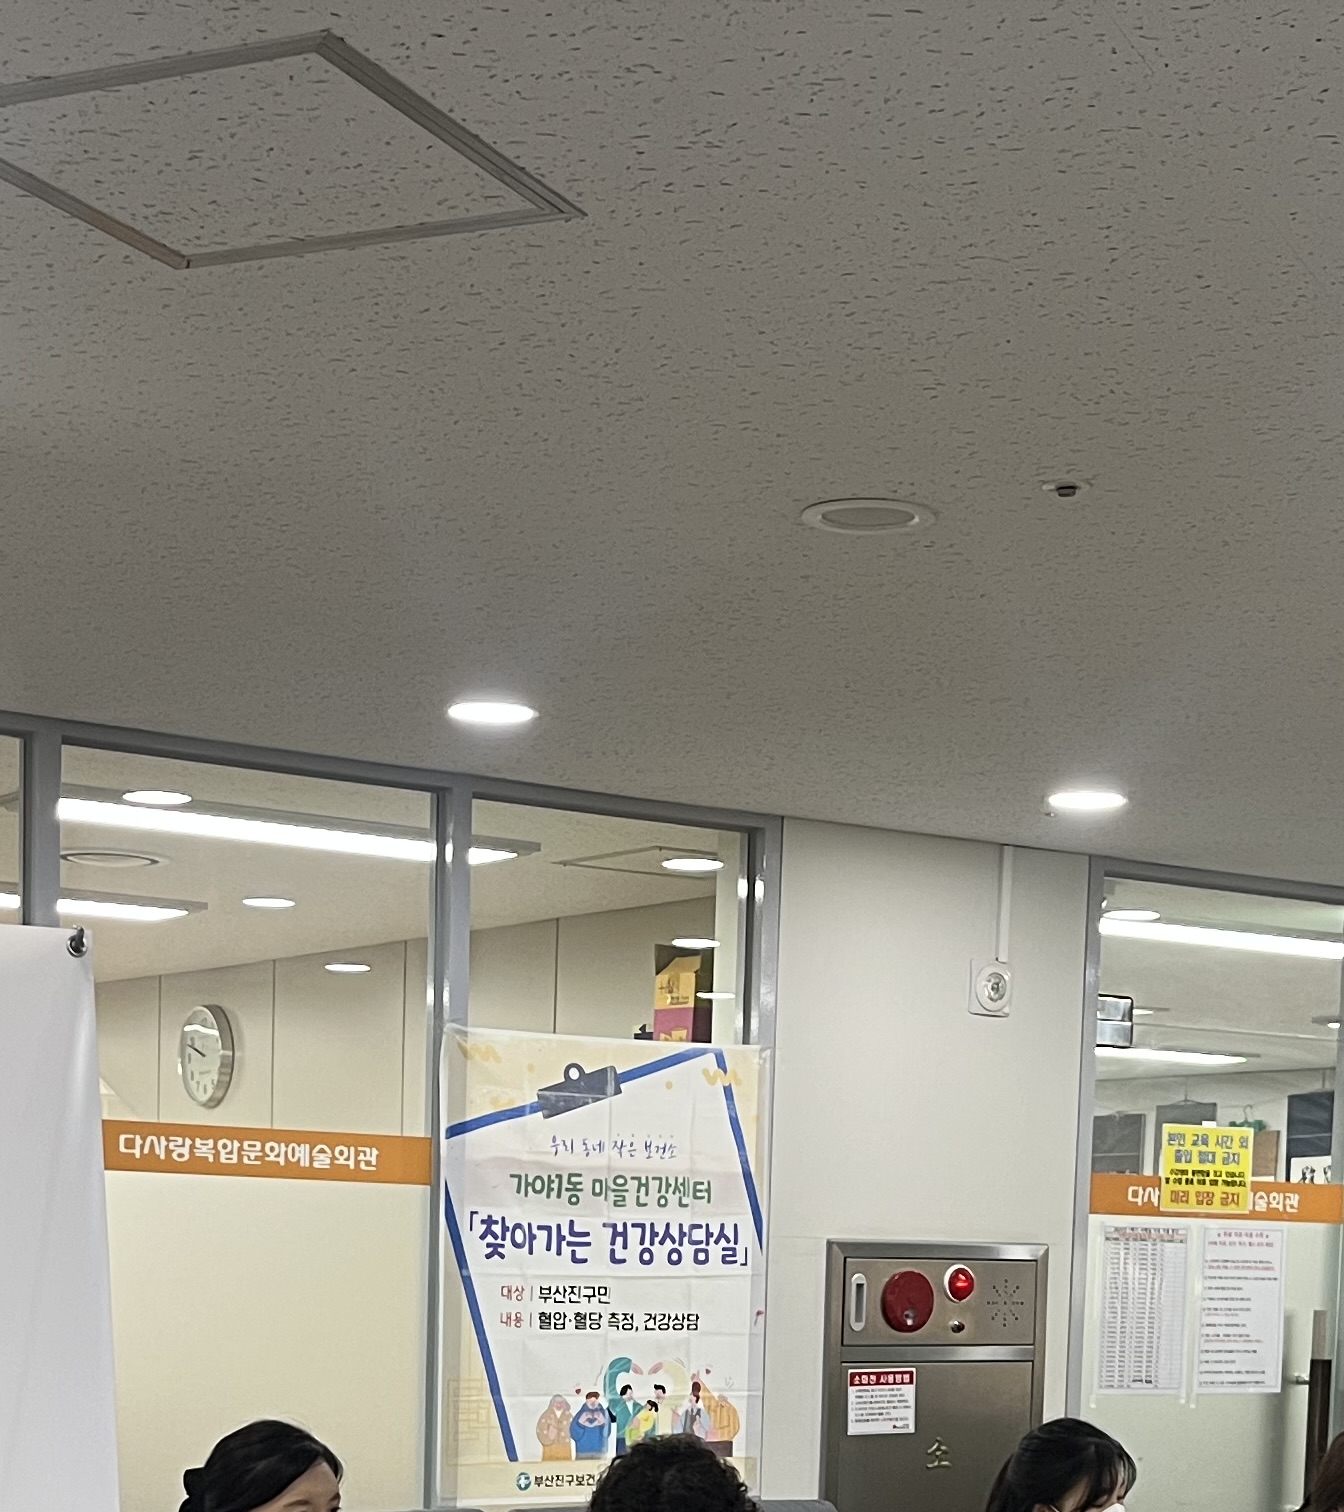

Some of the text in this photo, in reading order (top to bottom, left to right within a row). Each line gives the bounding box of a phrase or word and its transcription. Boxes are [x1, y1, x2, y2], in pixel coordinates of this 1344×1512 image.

[119, 1133, 379, 1171] 다사랑복합문화예술회관
[550, 1134, 677, 1159] 우리 동네 작은 보건소
[1222, 1151, 1240, 1166] 금지
[509, 1173, 713, 1208] 가야1동 마을건강센터
[1195, 1190, 1215, 1206] 입장
[1220, 1191, 1240, 1207] 금지
[500, 1285, 611, 1305] 대상 부산진구민
[499, 1311, 524, 1329] 내용
[607, 1312, 639, 1332] 측정,
[643, 1312, 700, 1331] 건강상담
[534, 1472, 599, 1488] 부산진구보건
